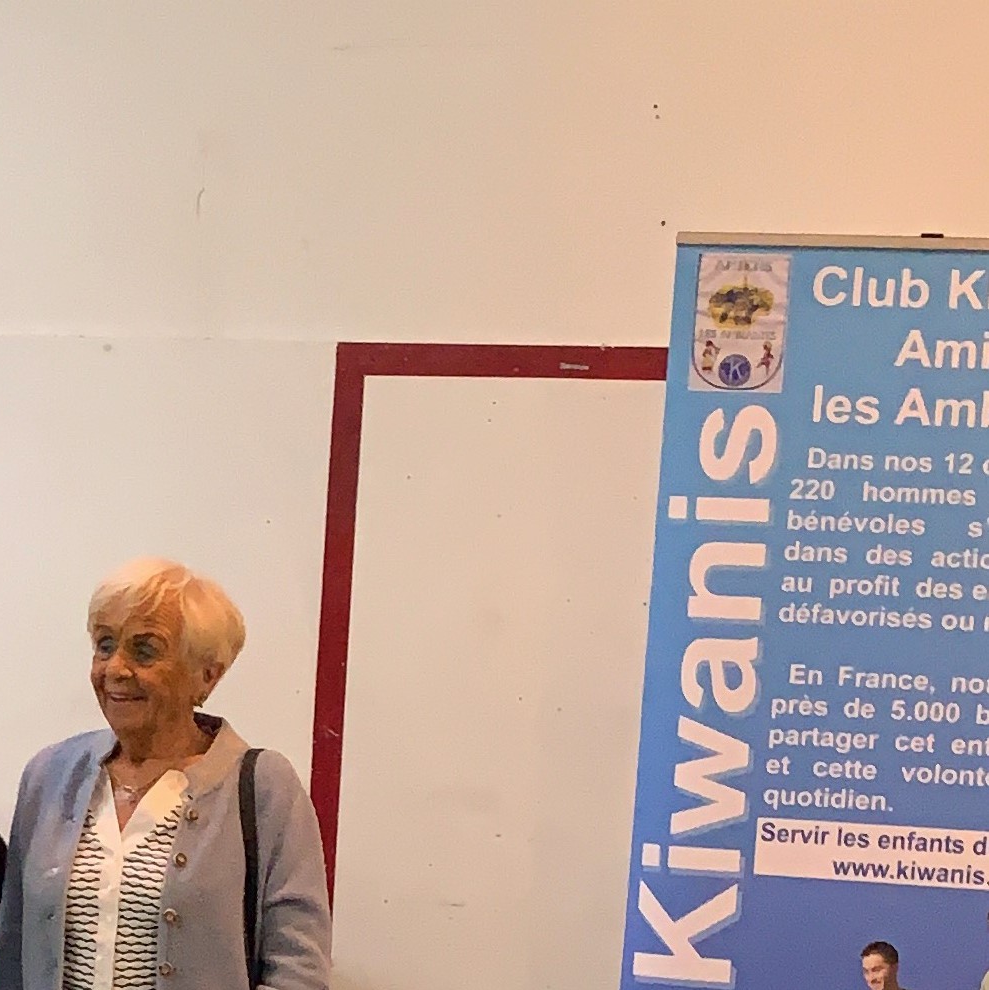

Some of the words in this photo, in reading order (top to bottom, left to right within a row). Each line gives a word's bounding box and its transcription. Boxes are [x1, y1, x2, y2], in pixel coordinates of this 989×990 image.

[813, 265, 930, 308] Club
[949, 268, 989, 310] K
[812, 385, 880, 425] les
[808, 447, 874, 471] Dans
[884, 454, 933, 474] nos
[944, 452, 975, 475] 12
[789, 479, 835, 501] 220
[863, 481, 977, 506] hommes
[786, 510, 926, 536] bénévoles
[784, 541, 848, 564] dans
[866, 544, 913, 567] des
[781, 577, 813, 593] au
[829, 575, 900, 599] profit
[915, 577, 963, 600] des
[778, 603, 933, 630] défavorisés
[941, 614, 975, 631] ou
[788, 664, 823, 686] En
[838, 666, 936, 695] France,
[632, 404, 777, 984] Kiwanis
[770, 696, 828, 720] près
[843, 698, 876, 720] de
[891, 700, 960, 724] 5.000
[768, 728, 879, 754] partager
[895, 733, 935, 753] cet
[765, 757, 791, 776] et
[812, 758, 877, 780] cette
[901, 764, 989, 787] volont
[763, 788, 894, 812] quotidien.
[760, 822, 830, 845] Servir
[837, 828, 870, 849] les
[878, 830, 965, 856] enfants
